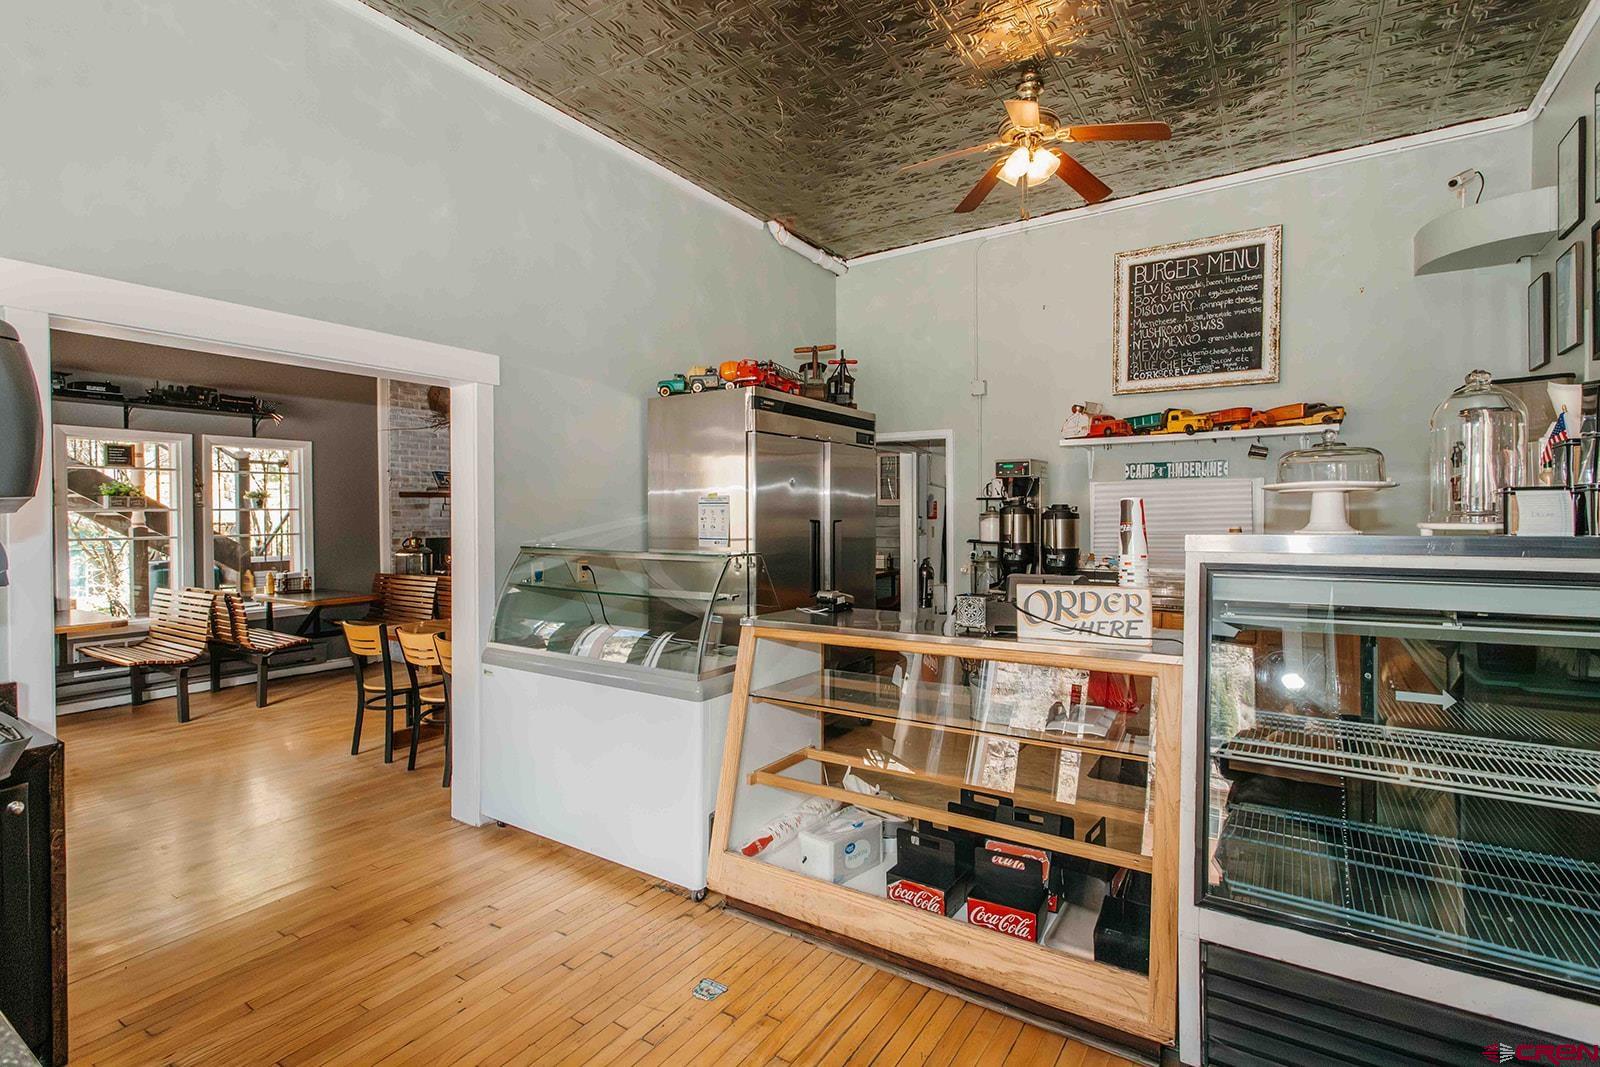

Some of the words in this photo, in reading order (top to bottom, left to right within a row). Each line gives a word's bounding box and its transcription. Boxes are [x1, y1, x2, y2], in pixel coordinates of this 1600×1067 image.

[1133, 258, 1201, 285] BURGER
[1206, 246, 1259, 275] MENU
[1134, 296, 1159, 308] BOX
[1133, 323, 1188, 340] MUSHROOM
[1133, 338, 1160, 351] NEW
[1131, 360, 1159, 375] BLUE
[1130, 463, 1156, 479] CAMP
[1167, 461, 1223, 478] TIMBERLINE
[1023, 589, 1145, 625] ORDER
[1075, 619, 1144, 638] HERE
[970, 906, 1032, 939] Coca-Cola
